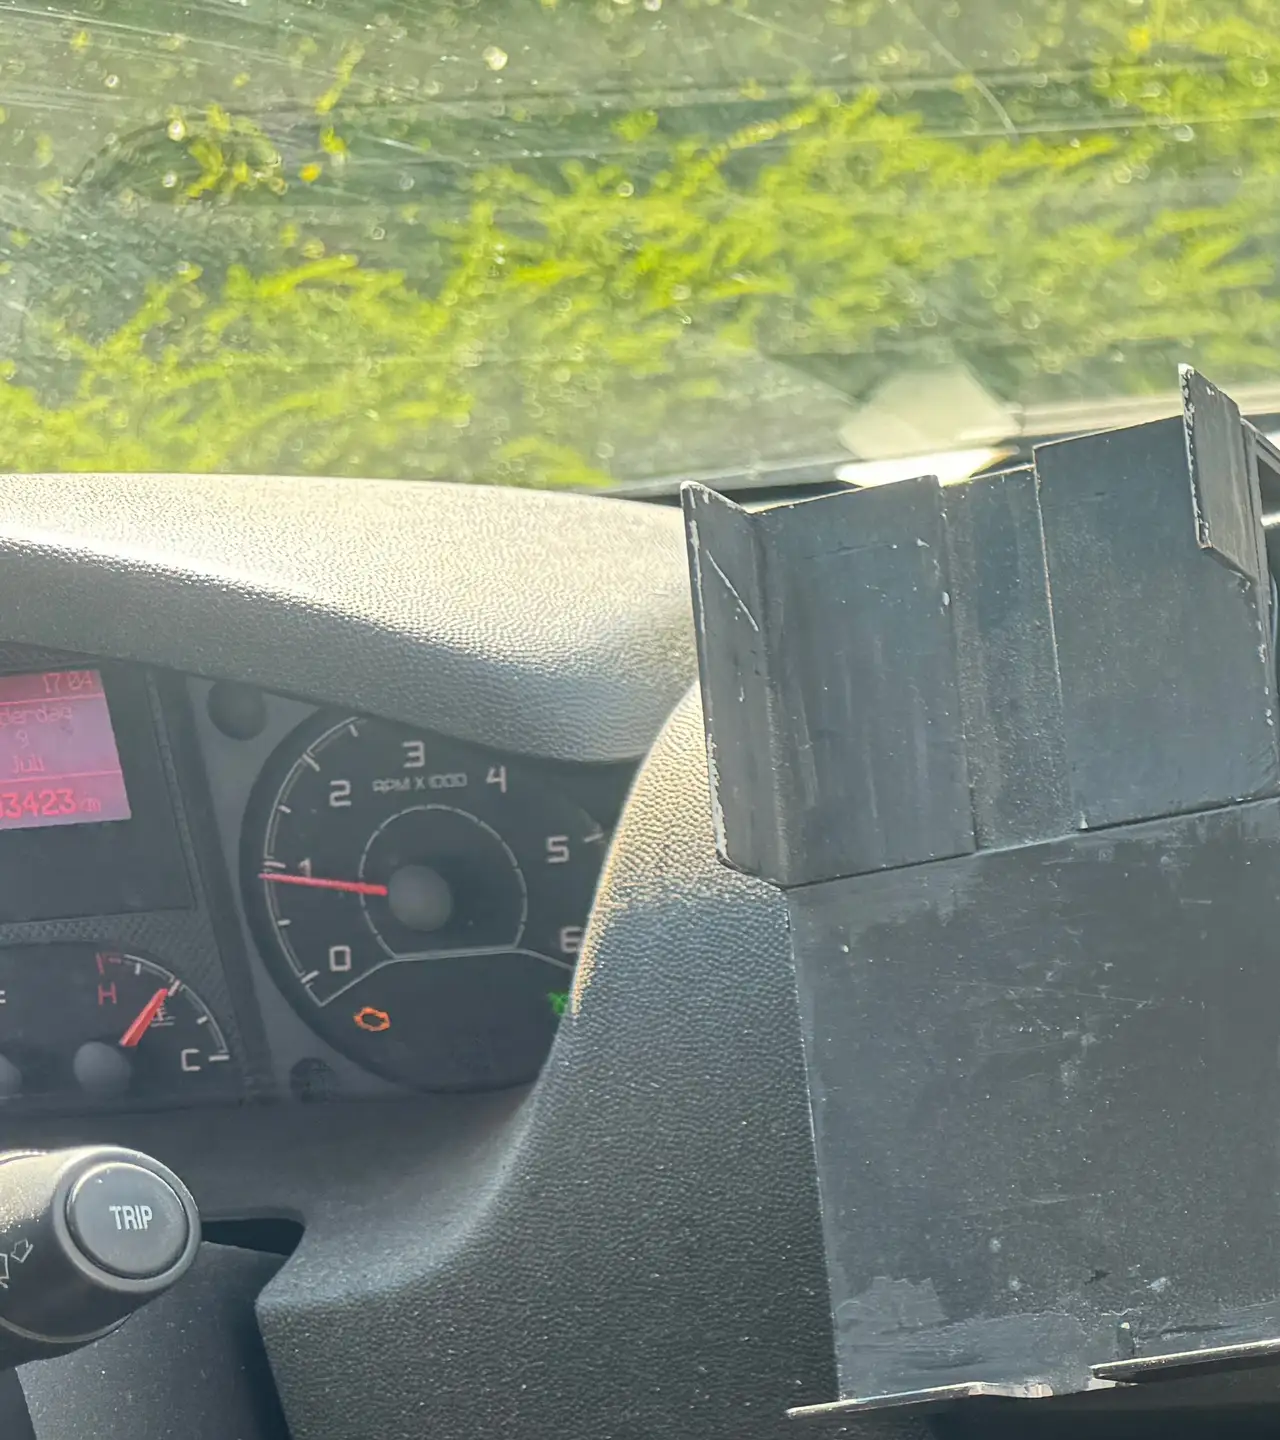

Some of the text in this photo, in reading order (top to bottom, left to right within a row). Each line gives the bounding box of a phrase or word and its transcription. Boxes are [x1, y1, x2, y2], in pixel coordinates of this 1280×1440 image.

[402, 741, 425, 768] 3
[329, 779, 352, 807] 2
[486, 765, 508, 794] 4
[0, 788, 78, 819] 3423
[547, 836, 570, 864] 5
[329, 945, 352, 973] 0
[98, 982, 118, 1006] H
[181, 1048, 202, 1072] C
[108, 1204, 153, 1231] TRIP
